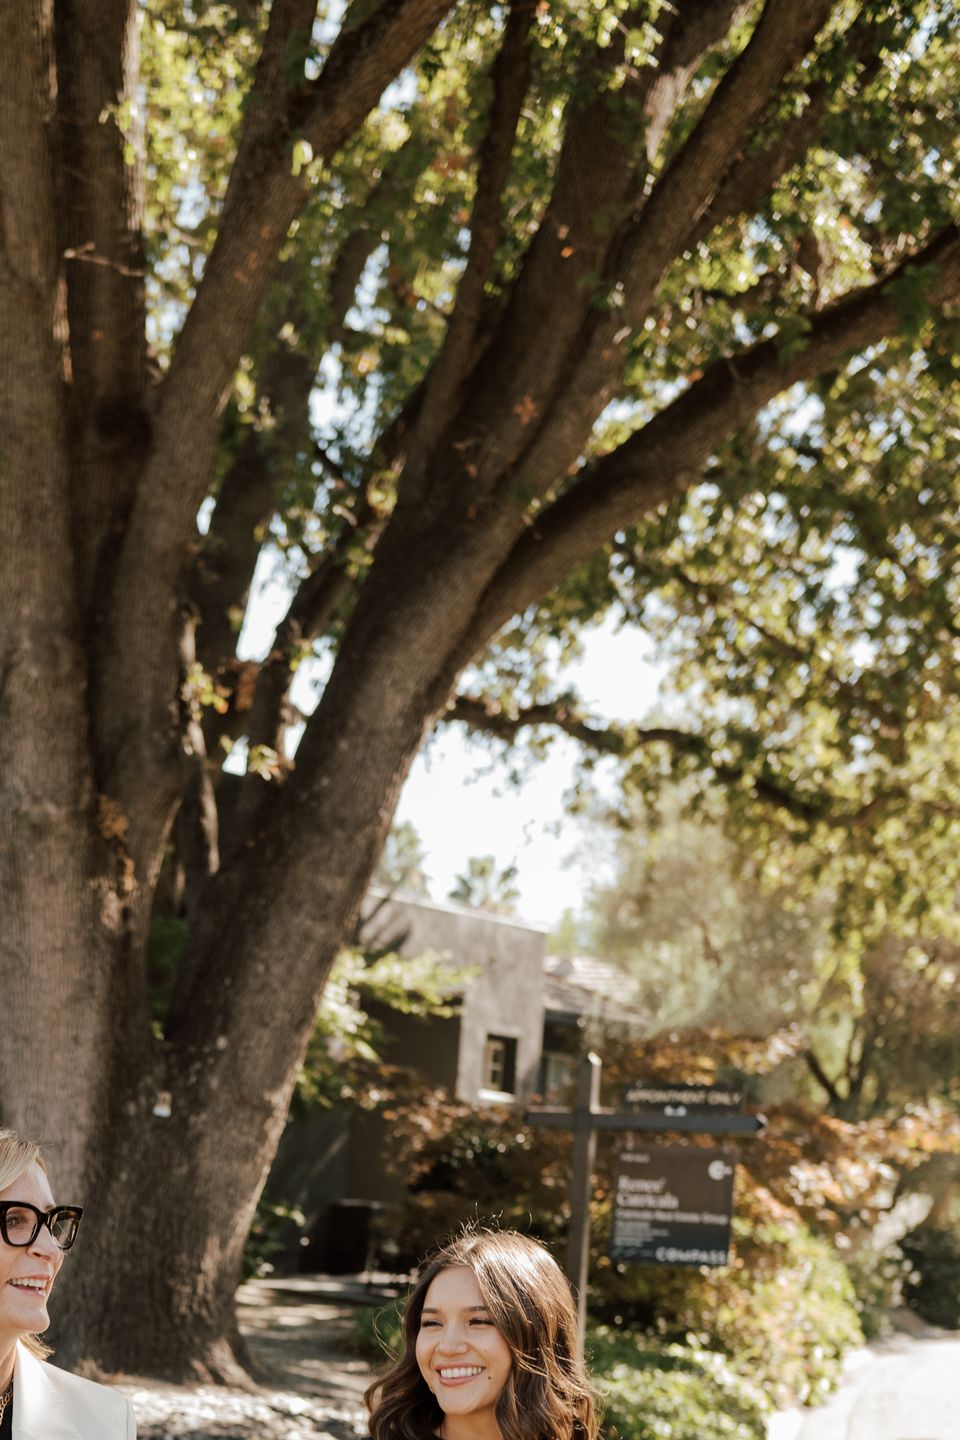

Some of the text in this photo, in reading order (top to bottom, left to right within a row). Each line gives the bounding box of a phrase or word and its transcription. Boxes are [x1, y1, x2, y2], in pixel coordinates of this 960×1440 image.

[626, 1089, 742, 1106] APPOINTMENT ONLY
[655, 1246, 727, 1265] COMPASS
